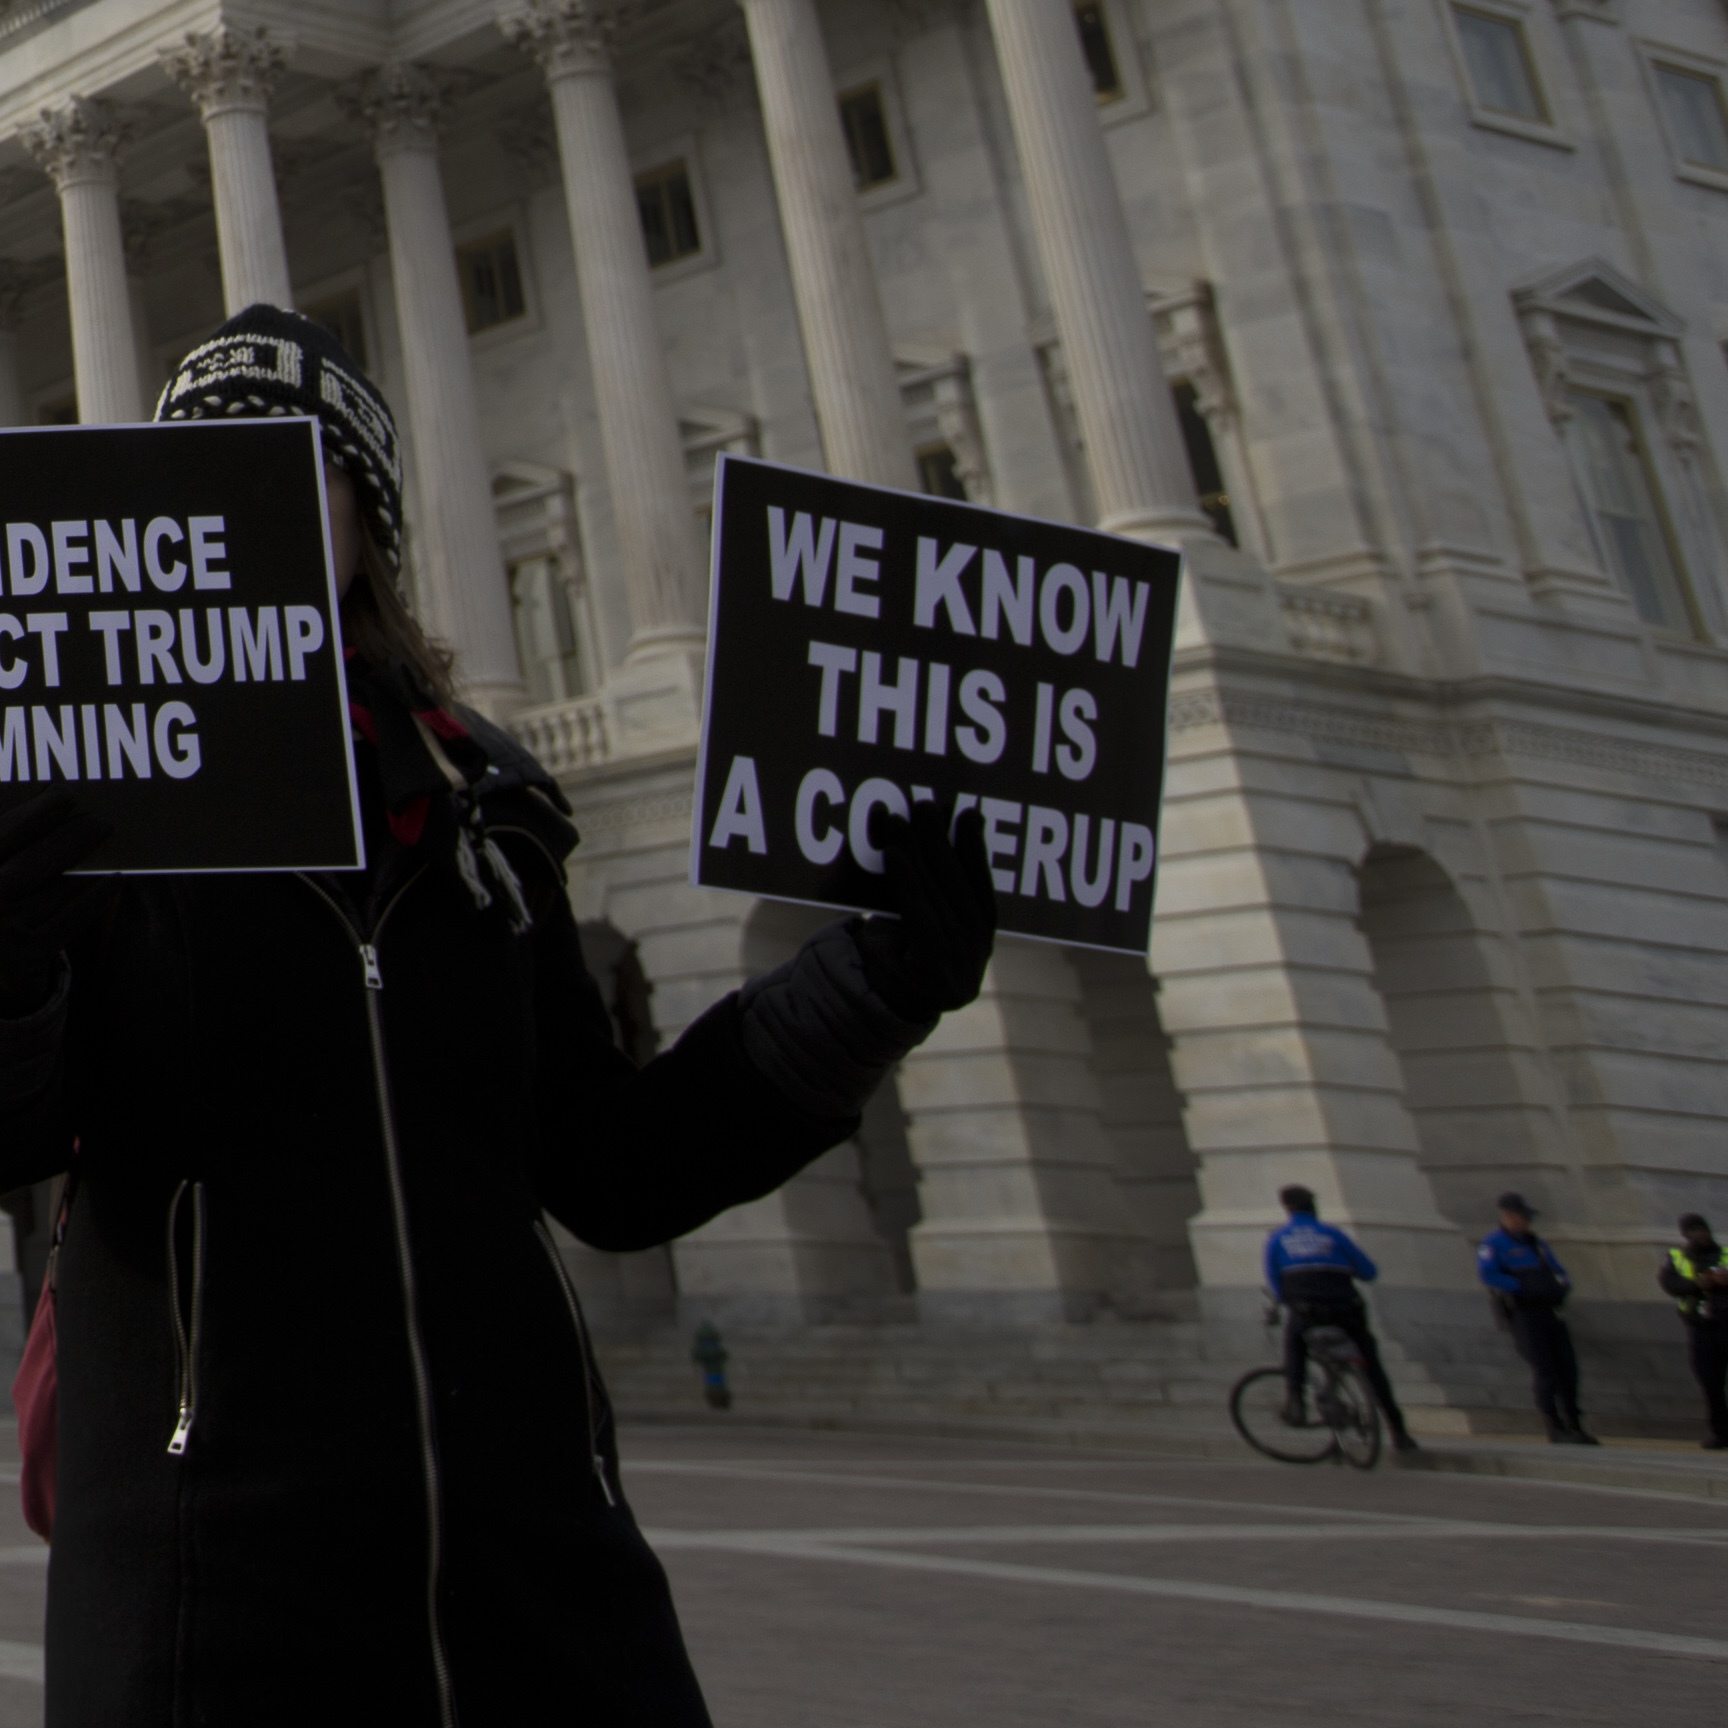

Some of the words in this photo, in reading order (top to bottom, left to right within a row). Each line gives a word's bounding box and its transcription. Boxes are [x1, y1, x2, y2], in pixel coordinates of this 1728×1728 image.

[89, 605, 324, 685] TRUMP
[767, 505, 883, 618] WE
[913, 536, 1150, 667] KNOW
[808, 641, 1007, 764] THIS
[1032, 682, 1098, 781] IS
[709, 755, 767, 854] A
